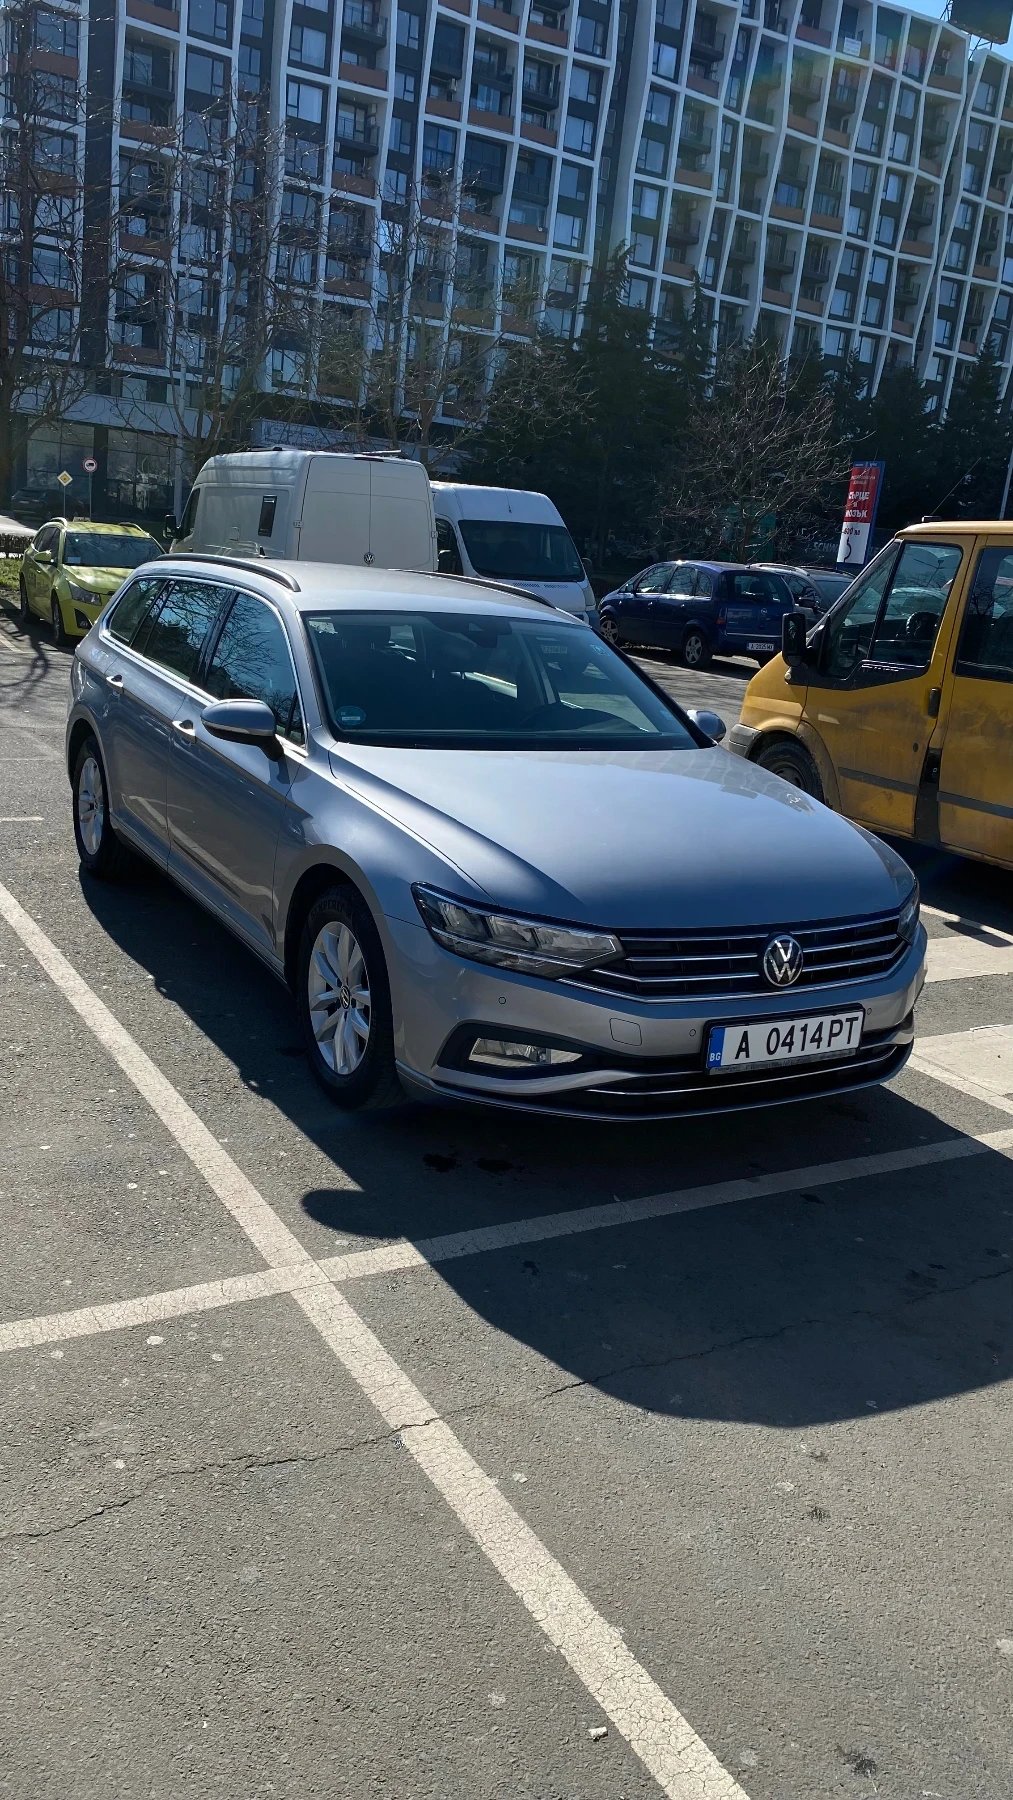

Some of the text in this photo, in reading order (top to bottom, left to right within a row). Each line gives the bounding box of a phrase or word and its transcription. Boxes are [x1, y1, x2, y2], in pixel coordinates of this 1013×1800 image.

[845, 509, 868, 518] МОЗЪК
[764, 937, 803, 985] VW
[709, 1016, 859, 1061] BG A 0414PT
